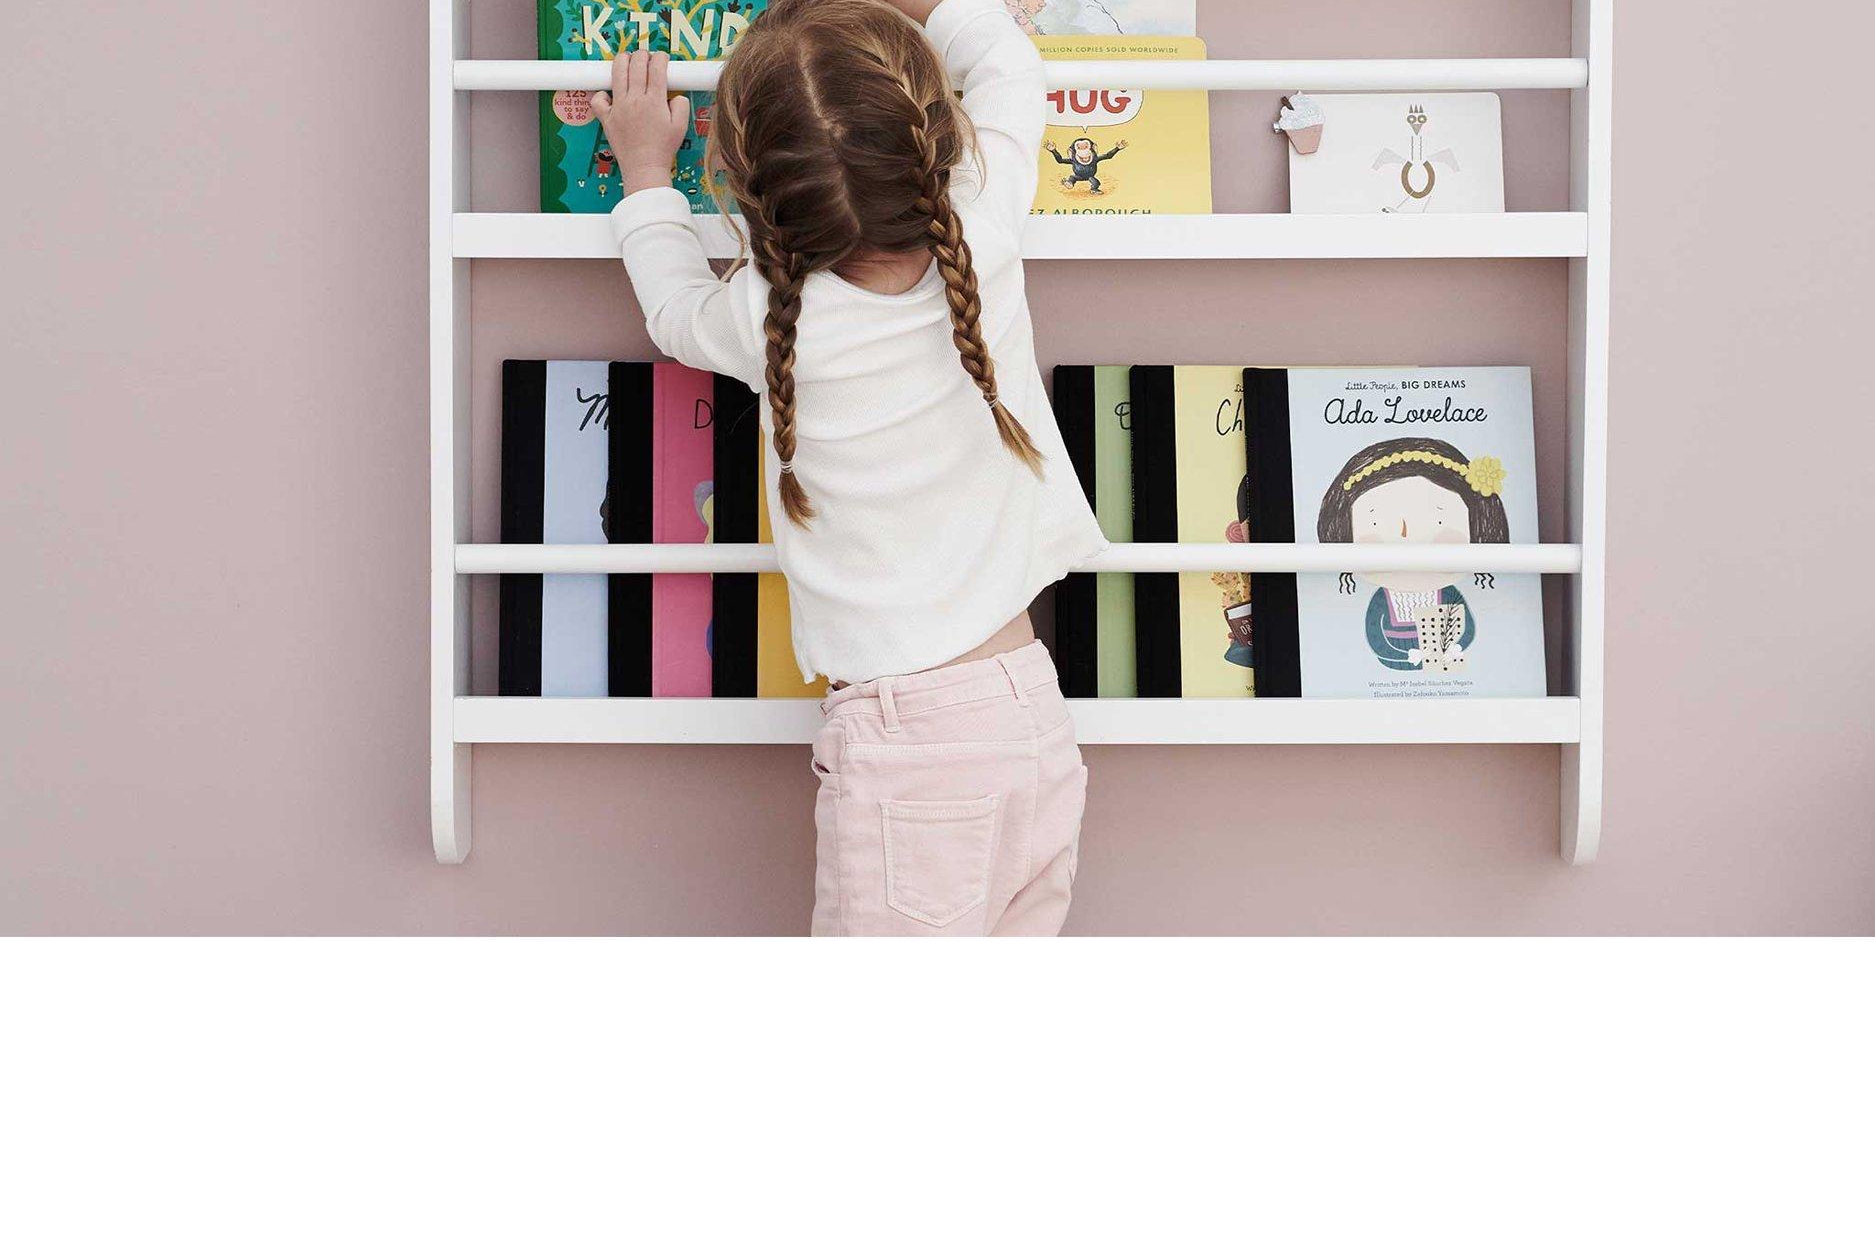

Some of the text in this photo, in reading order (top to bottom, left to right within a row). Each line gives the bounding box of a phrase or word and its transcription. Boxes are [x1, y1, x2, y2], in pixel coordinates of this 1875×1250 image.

[581, 5, 751, 56] KIND
[566, 112, 586, 120] & do
[1345, 382, 1368, 391] Little
[1401, 380, 1420, 390] BIG
[1424, 380, 1466, 389] DREAMS
[1324, 395, 1488, 425] Ada Lovelace
